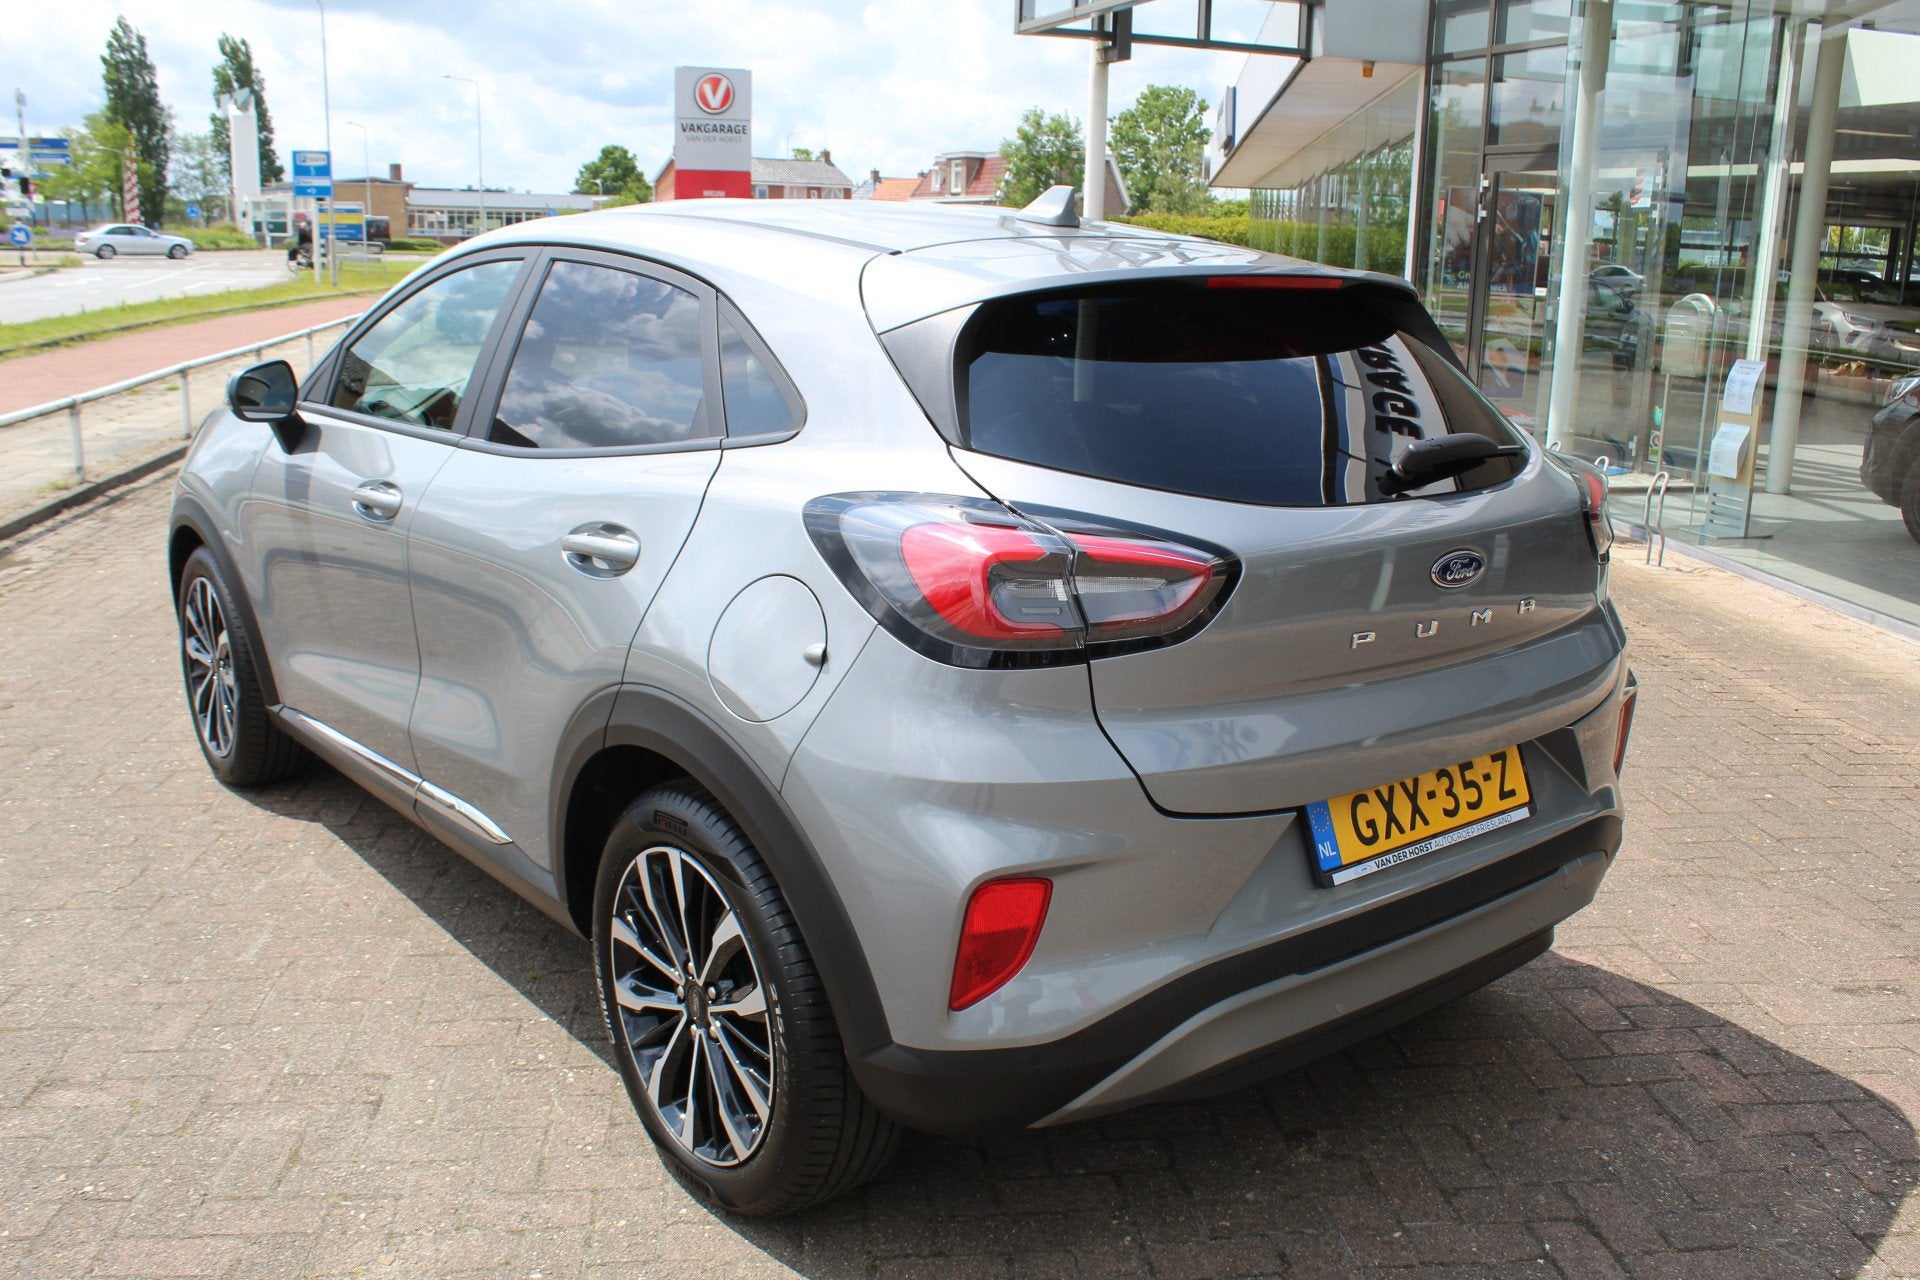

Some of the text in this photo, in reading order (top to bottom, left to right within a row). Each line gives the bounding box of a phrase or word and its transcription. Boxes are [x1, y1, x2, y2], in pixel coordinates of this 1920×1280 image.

[681, 122, 748, 135] VAKGARAGE
[686, 134, 742, 144] VAN DER HORST
[1446, 558, 1475, 580] Ford
[1351, 597, 1536, 649] PUMA
[1350, 751, 1517, 846] GXX-35-Z
[1318, 840, 1337, 859] NL
[1374, 814, 1513, 869] VAN DER HORST AUTOGROEP FRIESLAND
